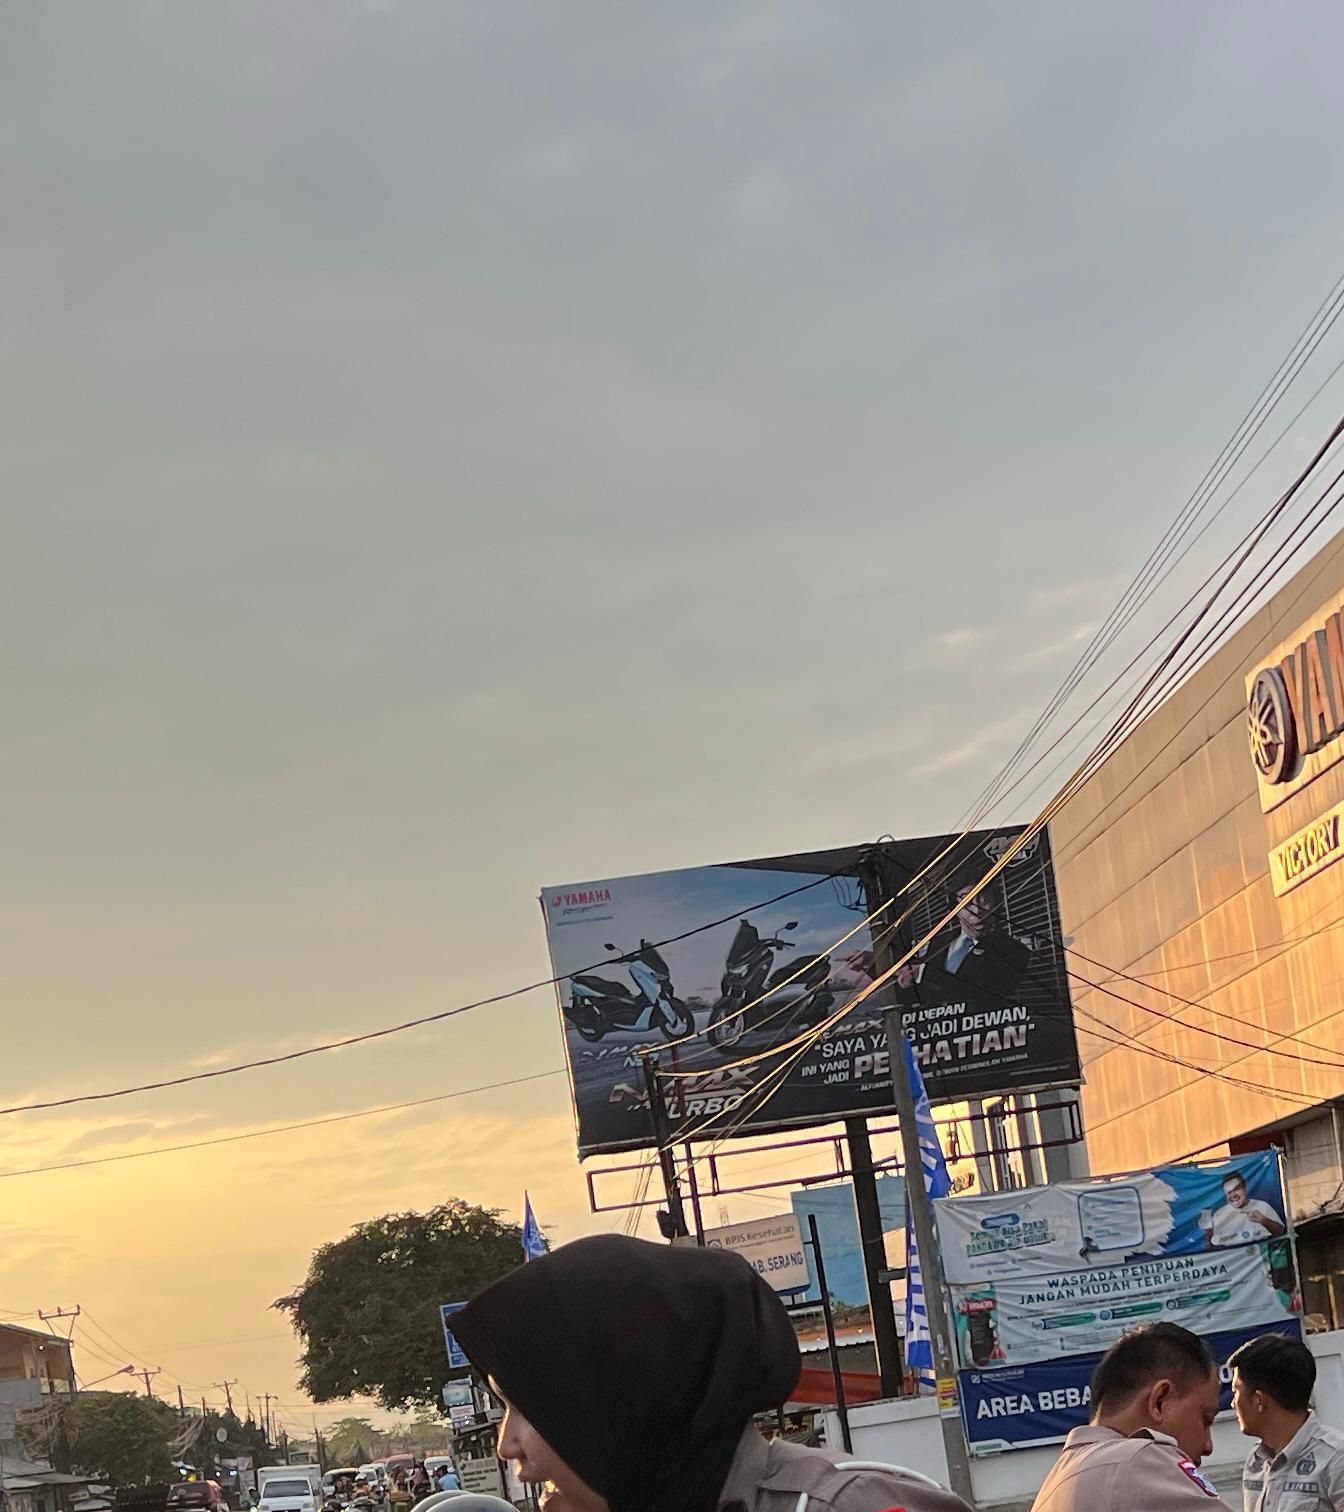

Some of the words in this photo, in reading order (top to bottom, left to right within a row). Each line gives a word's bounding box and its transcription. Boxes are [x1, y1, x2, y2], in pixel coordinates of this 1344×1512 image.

[1277, 813, 1340, 881] VICTORY
[563, 889, 612, 907] YAMAHA
[901, 1011, 917, 1028] DI
[919, 1018, 958, 1040] JADI
[961, 1006, 1032, 1033] DEWAN,
[823, 1071, 850, 1086] JADI
[854, 1023, 1036, 1080] PEHATIAN"
[801, 1065, 818, 1078] INI
[818, 1058, 851, 1074] YANG
[724, 1232, 746, 1247] BPJS
[768, 1250, 805, 1272] SERANG
[1046, 1268, 1118, 1289] WASPADA
[1121, 1257, 1195, 1278] PENIPUAN
[1018, 1290, 1079, 1306] JANGAN
[1080, 1278, 1132, 1298] MUDAH
[1134, 1263, 1229, 1288] TERPERDAYA
[976, 1395, 1036, 1420] AREA
